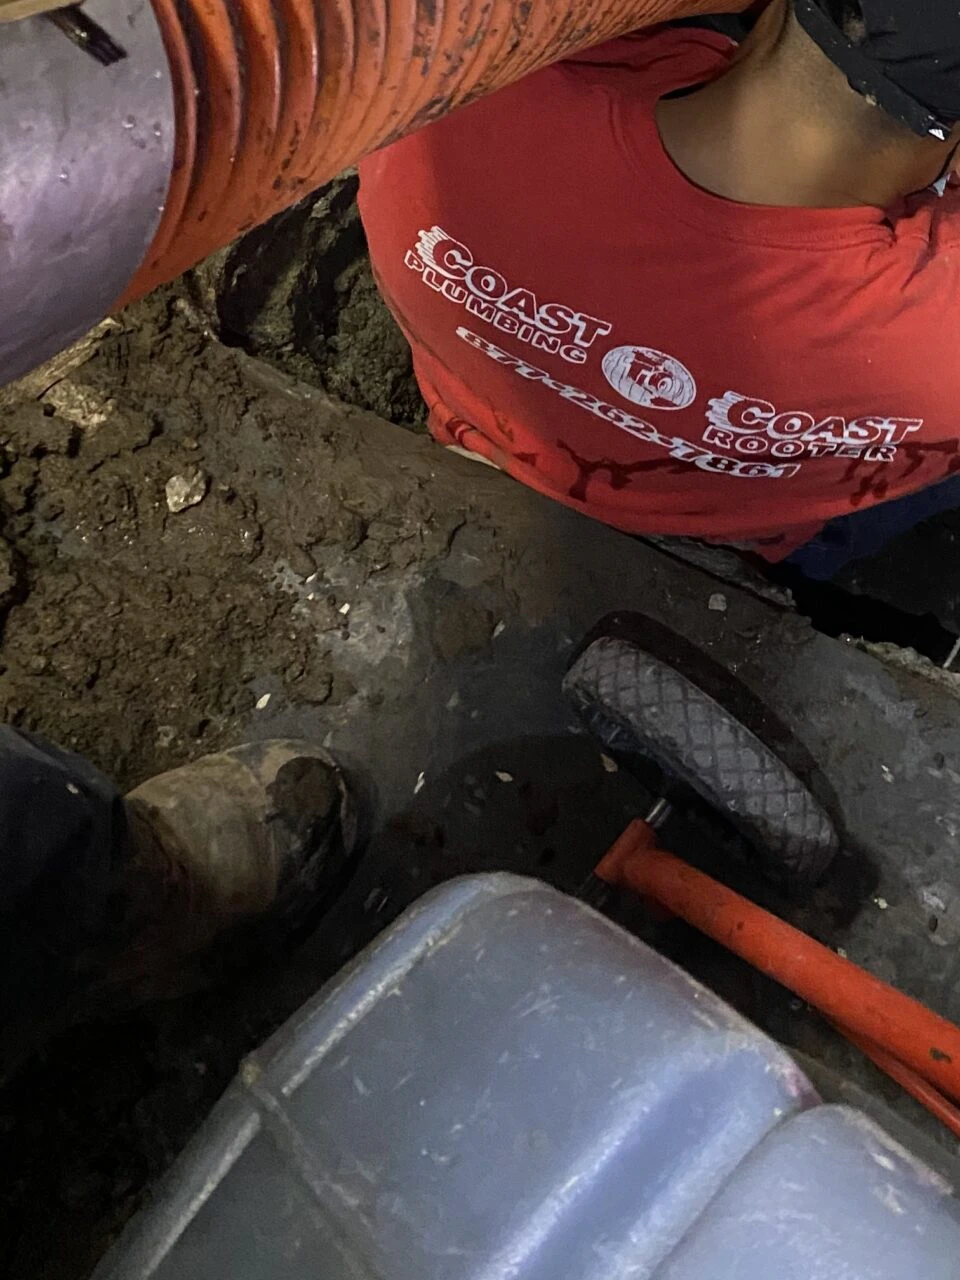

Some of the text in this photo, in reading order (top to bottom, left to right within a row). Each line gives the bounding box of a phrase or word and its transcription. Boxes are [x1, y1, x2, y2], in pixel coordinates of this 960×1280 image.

[403, 249, 588, 364] PLUMBING
[415, 225, 613, 348] COAST
[704, 390, 924, 446] COAST
[702, 424, 898, 463] ROOTER
